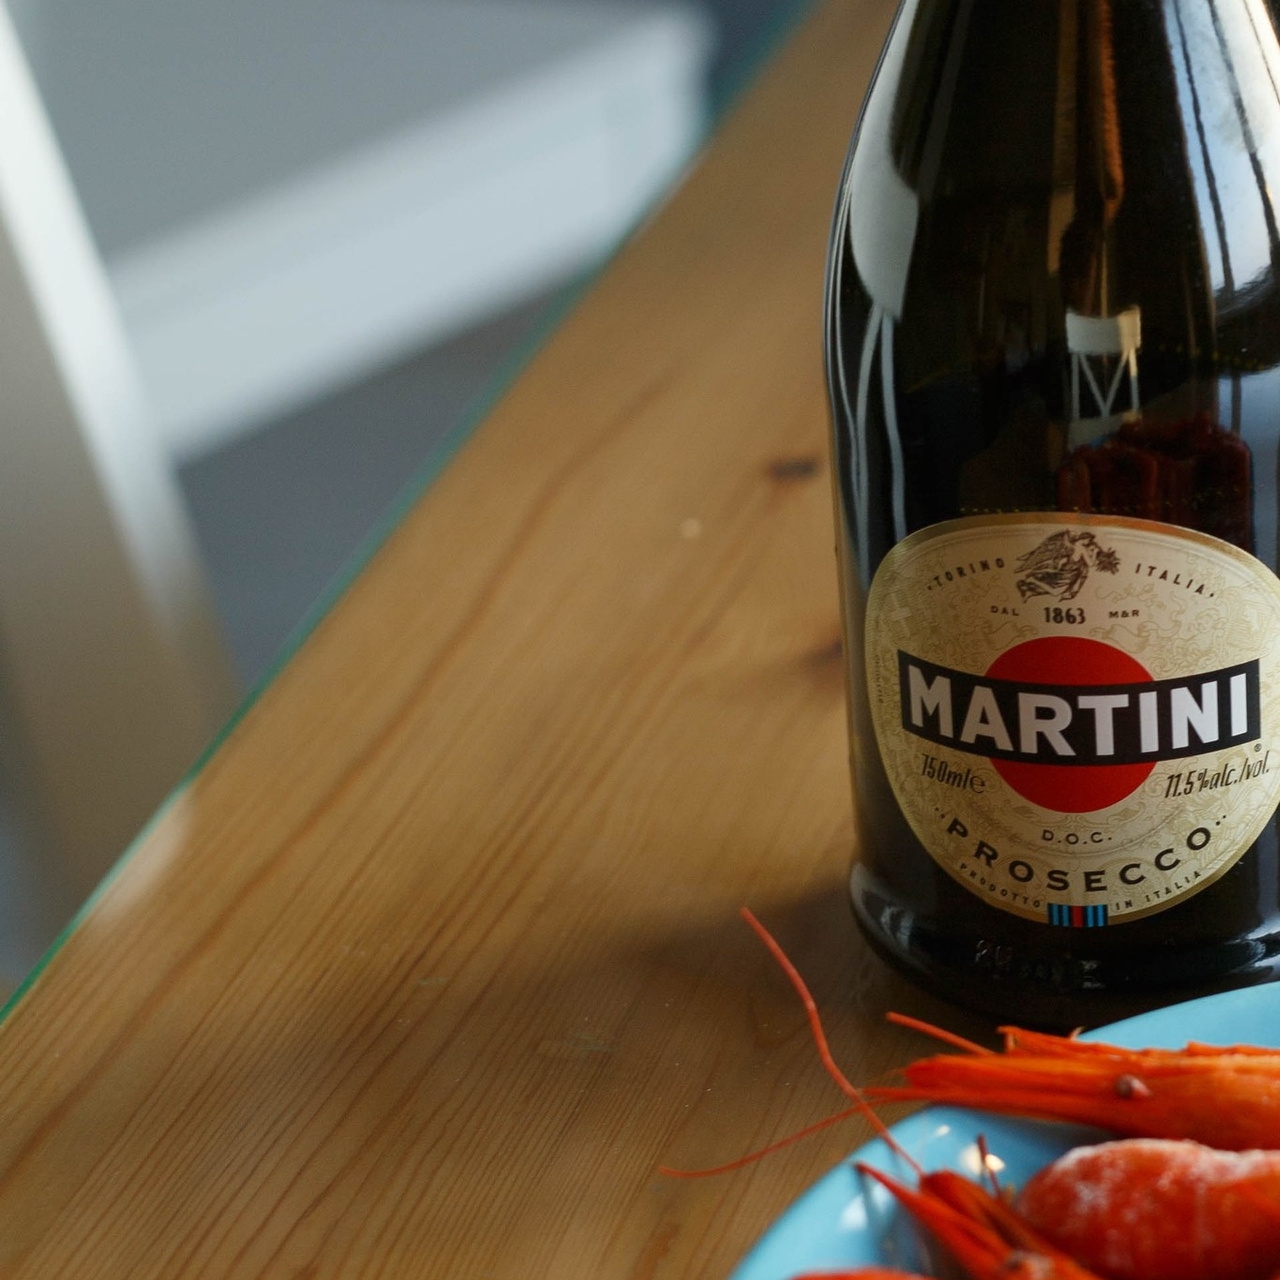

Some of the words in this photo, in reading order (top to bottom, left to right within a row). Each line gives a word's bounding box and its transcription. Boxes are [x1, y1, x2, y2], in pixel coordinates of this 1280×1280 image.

[933, 557, 1005, 587] TORINO
[1135, 563, 1207, 595] ITALIA
[990, 606, 1020, 617] DAL
[1043, 606, 1087, 625] 1863
[1108, 608, 1140, 619] M&R
[907, 664, 1248, 757] MARTINI
[947, 816, 1211, 892] PROSECCO
[1042, 829, 1112, 846] D.O.C.
[959, 862, 1041, 909] PRODOTTO
[1115, 899, 1133, 911] IN
[1146, 870, 1202, 903] ITALIA
